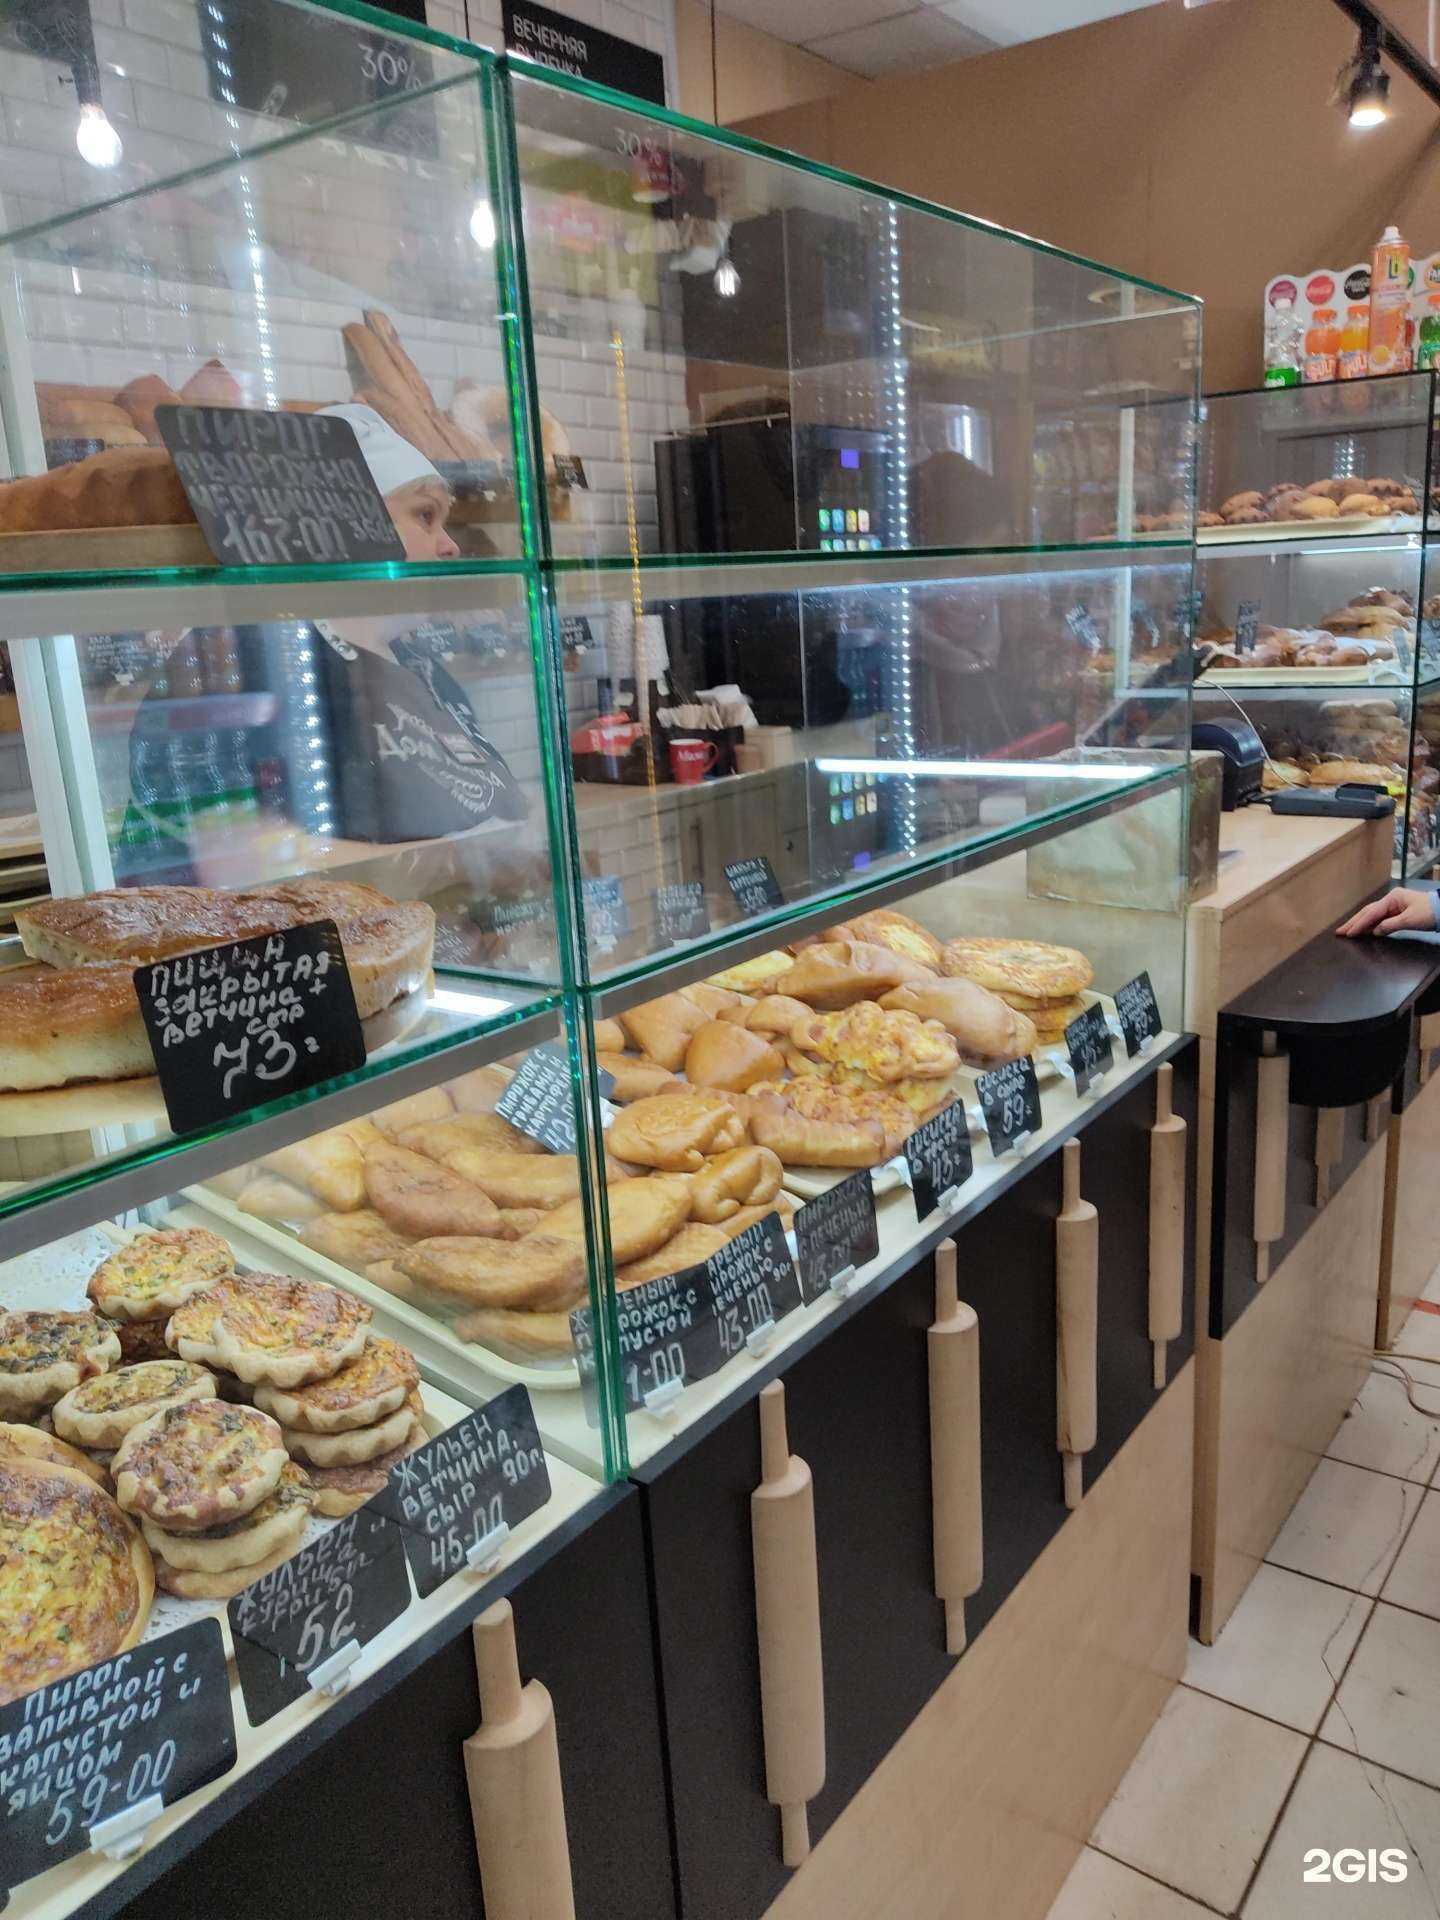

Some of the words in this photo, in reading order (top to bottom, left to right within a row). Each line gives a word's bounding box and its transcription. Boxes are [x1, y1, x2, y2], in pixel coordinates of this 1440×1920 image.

[357, 43, 423, 91] 30%
[512, 14, 589, 63] ВЕЧЕРНЯЯ
[177, 407, 330, 457] ПИРОГ
[494, 1057, 542, 1120] ПИРОЖОК
[511, 1065, 556, 1129] ГРИБАМИ
[706, 1219, 766, 1279] АРЕНЫЙ
[708, 1246, 764, 1297] ИРОЖОК
[710, 1256, 774, 1317] ЕЧЕНЬЮ
[626, 1340, 686, 1402] 1-00
[393, 1413, 493, 1498] ЖУЛЬЕН
[426, 1481, 476, 1534] СЫР
[0, 1656, 166, 1764] ЗАЛИВНОЙ
[24, 1653, 132, 1723] ПИРОГ
[0, 1689, 163, 1796] КАПУСТОЙ
[8, 1739, 123, 1817] ЯЙЦОМ
[45, 1738, 177, 1846] 59-00
